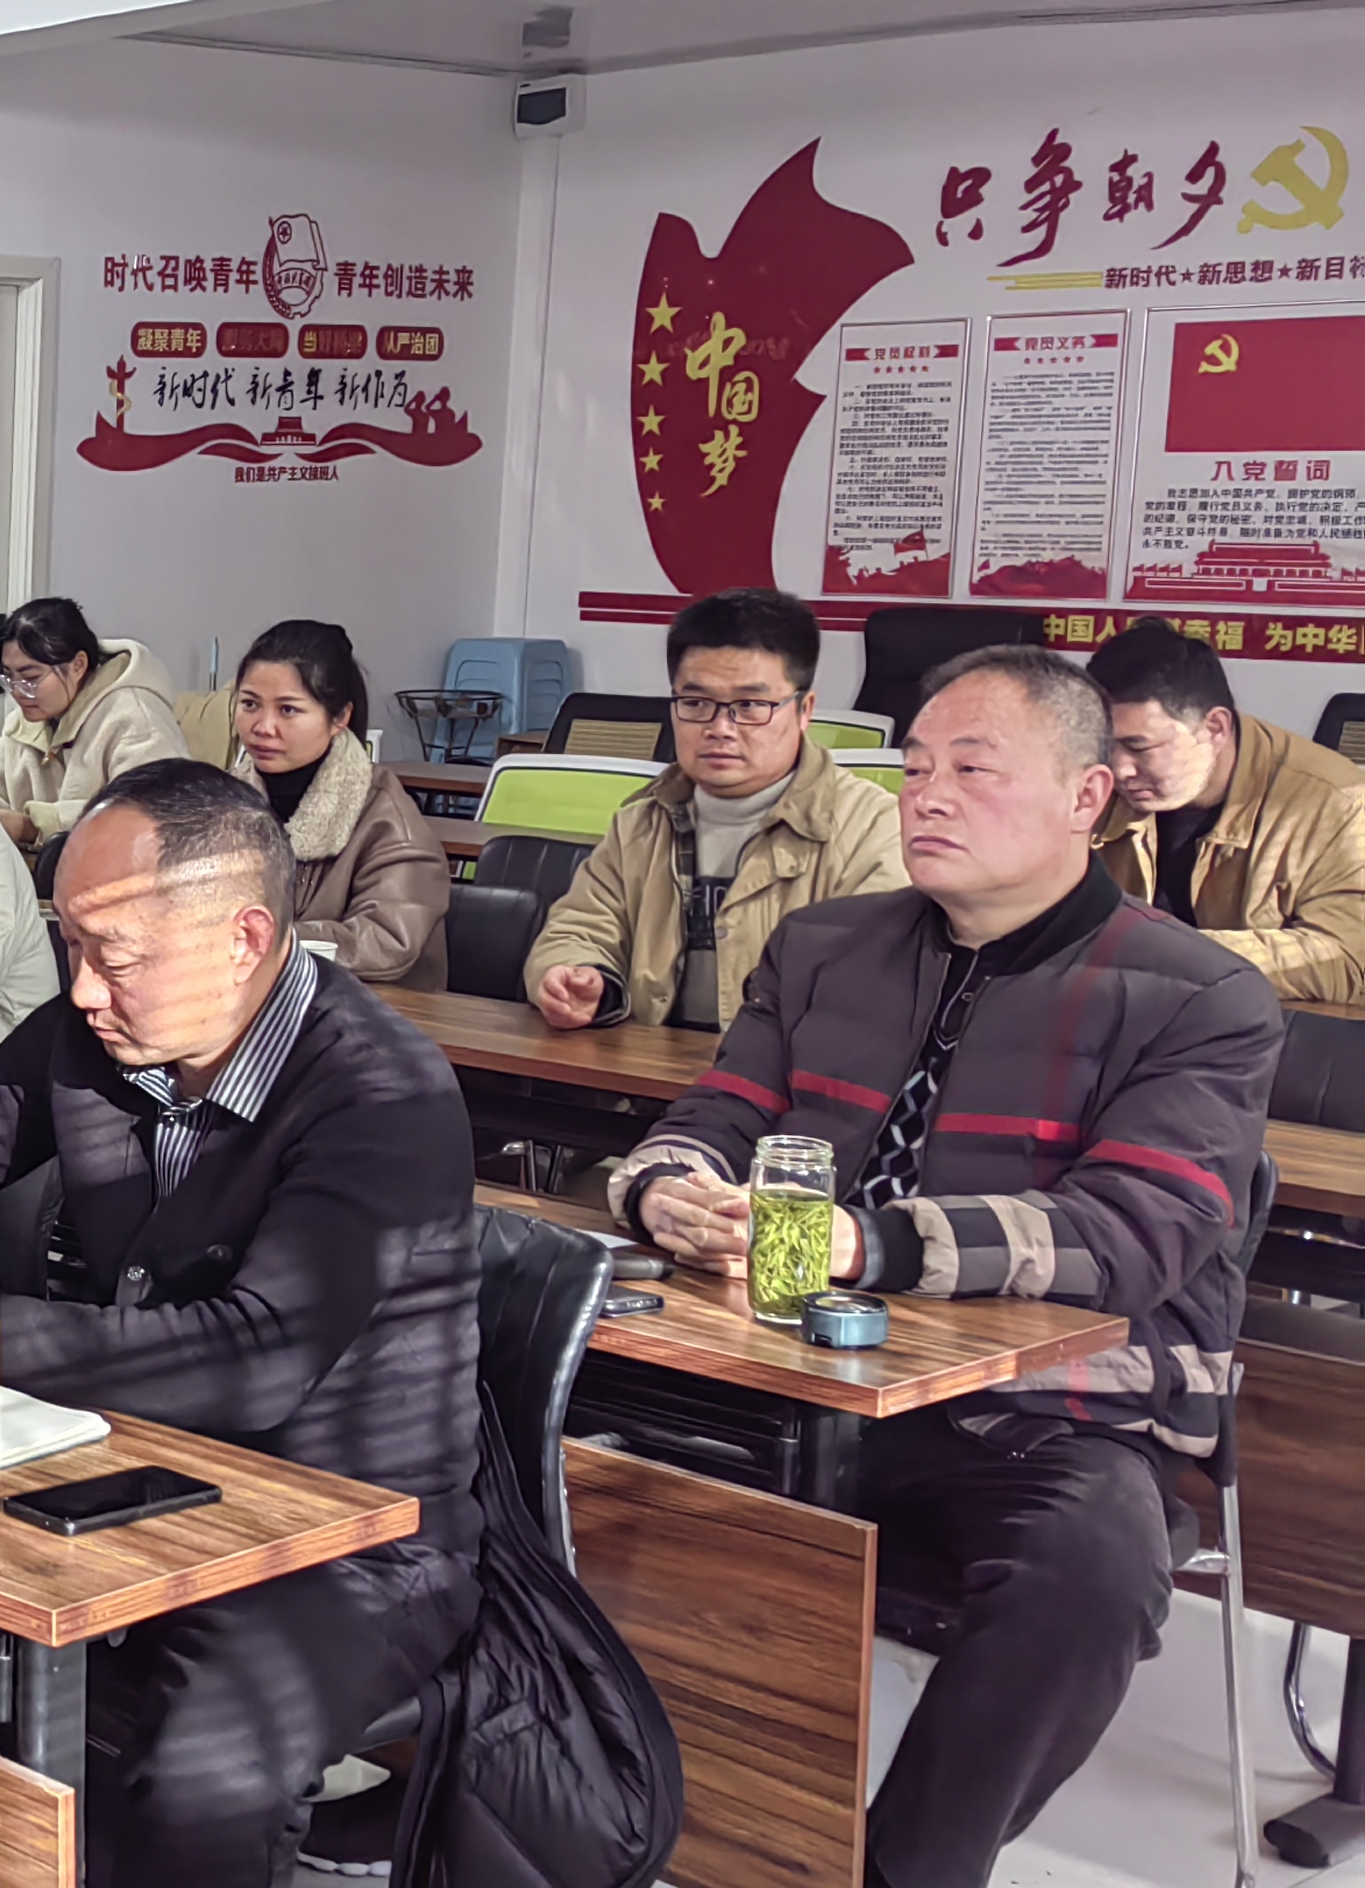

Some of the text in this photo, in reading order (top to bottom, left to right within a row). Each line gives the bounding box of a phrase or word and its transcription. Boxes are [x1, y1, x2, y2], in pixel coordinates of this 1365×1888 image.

[935, 127, 1227, 267] 只争朝夕
[103, 254, 475, 302] 时代召唤青年 青年创造未来
[1104, 265, 1177, 290] 新时代
[1197, 260, 1275, 285] 新思想
[137, 328, 203, 353] 凝聚青年
[383, 331, 439, 355] 从严治团
[153, 366, 408, 410] 新时代 新青年 新作为
[684, 311, 760, 497] 中国梦
[235, 465, 339, 483] 我们是共产主义接班人
[1210, 459, 1331, 481] 入党誓词
[1264, 622, 1365, 655] 为中华
